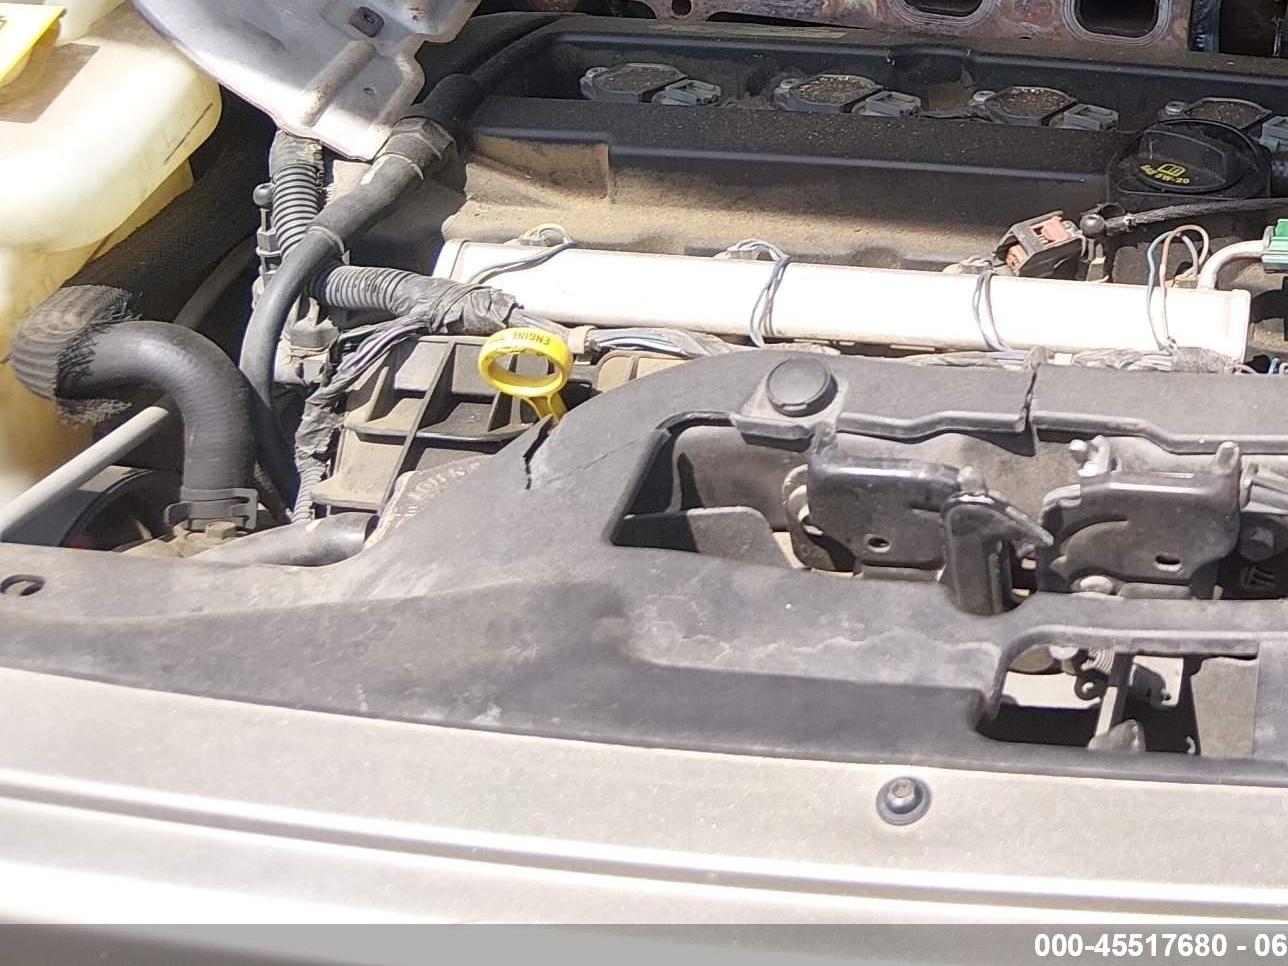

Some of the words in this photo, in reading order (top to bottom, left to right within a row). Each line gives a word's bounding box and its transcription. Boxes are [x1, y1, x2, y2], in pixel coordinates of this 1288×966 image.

[1140, 164, 1158, 175] SAE
[1154, 174, 1190, 184] 5W-20
[512, 331, 551, 345] ENGINE
